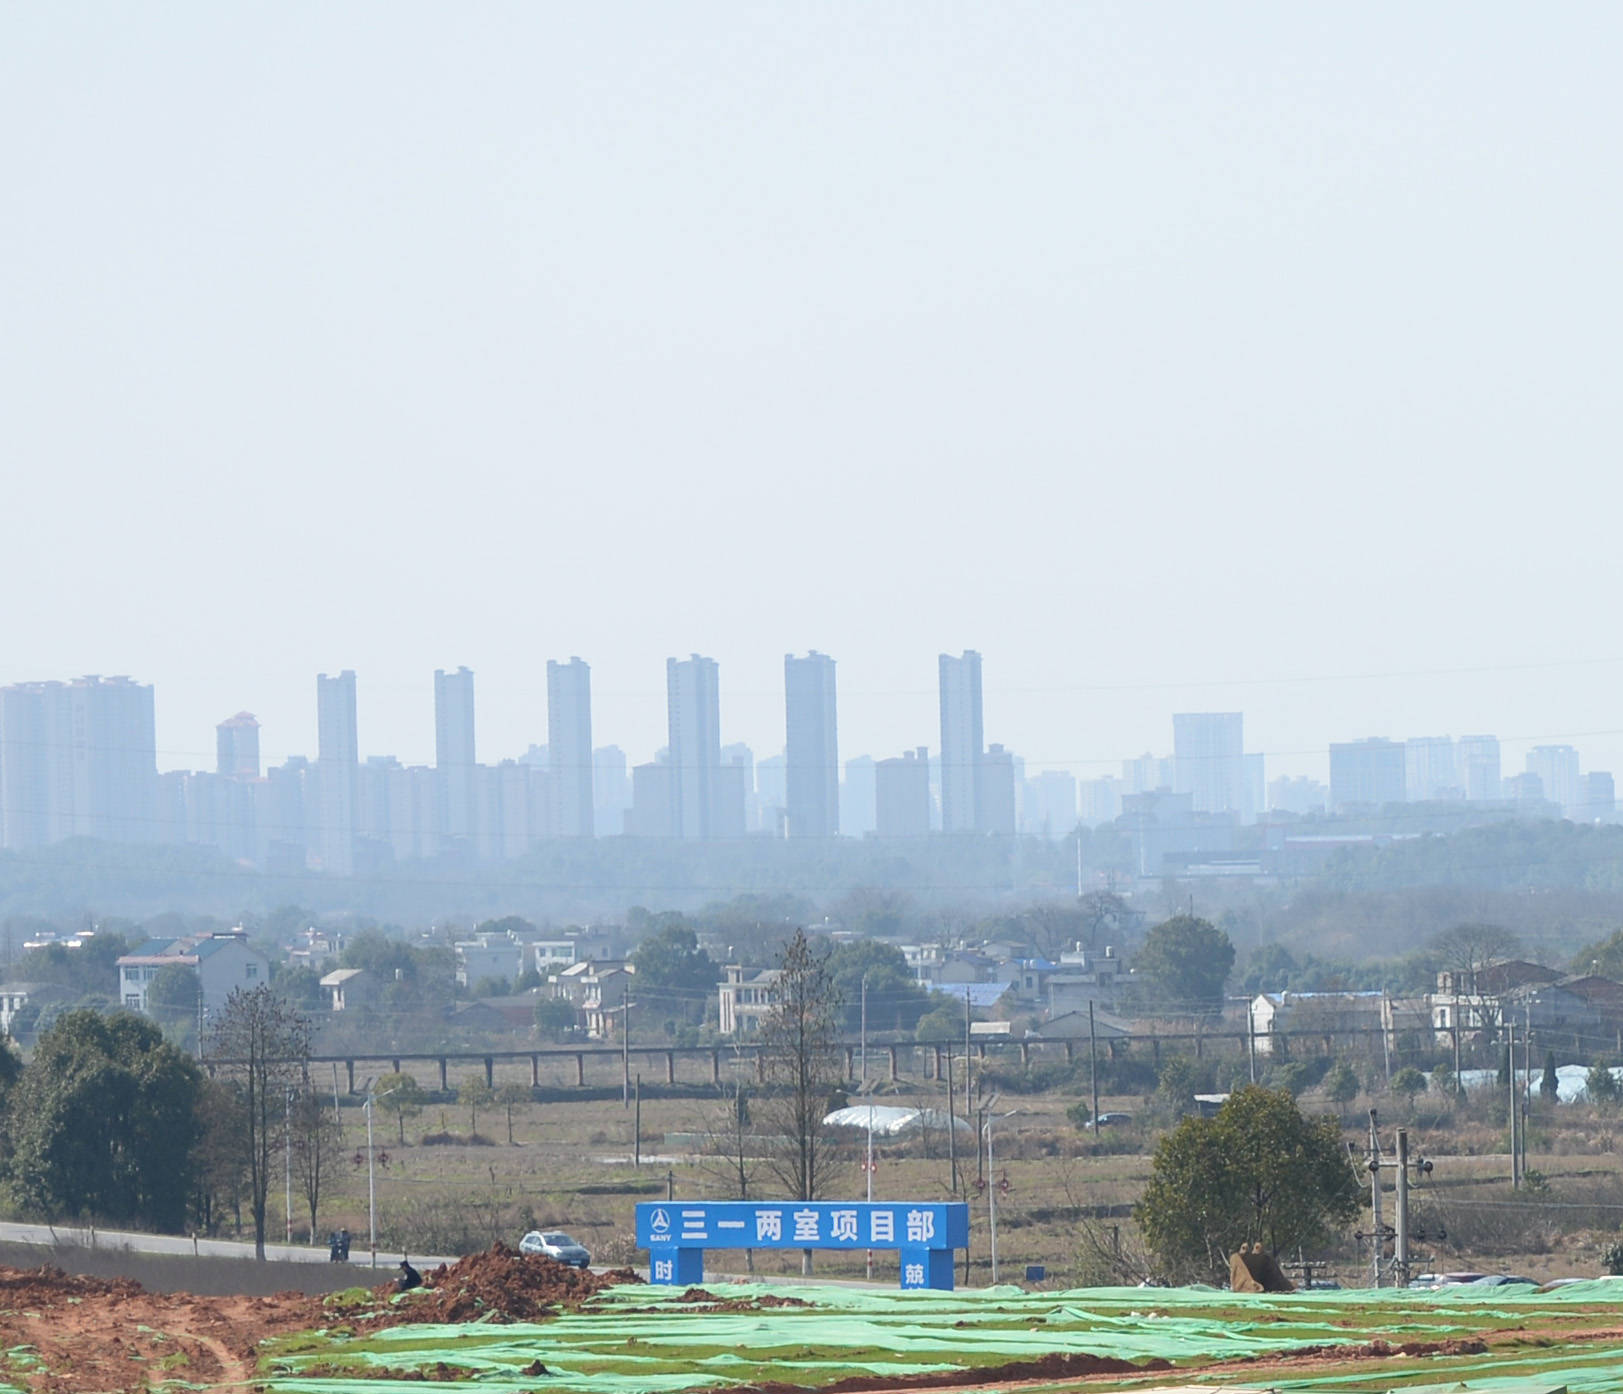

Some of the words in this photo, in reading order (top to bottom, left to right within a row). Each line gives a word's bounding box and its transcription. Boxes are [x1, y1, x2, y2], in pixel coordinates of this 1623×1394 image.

[681, 1209, 934, 1241] 三一两室项目部
[655, 1260, 673, 1280] 时
